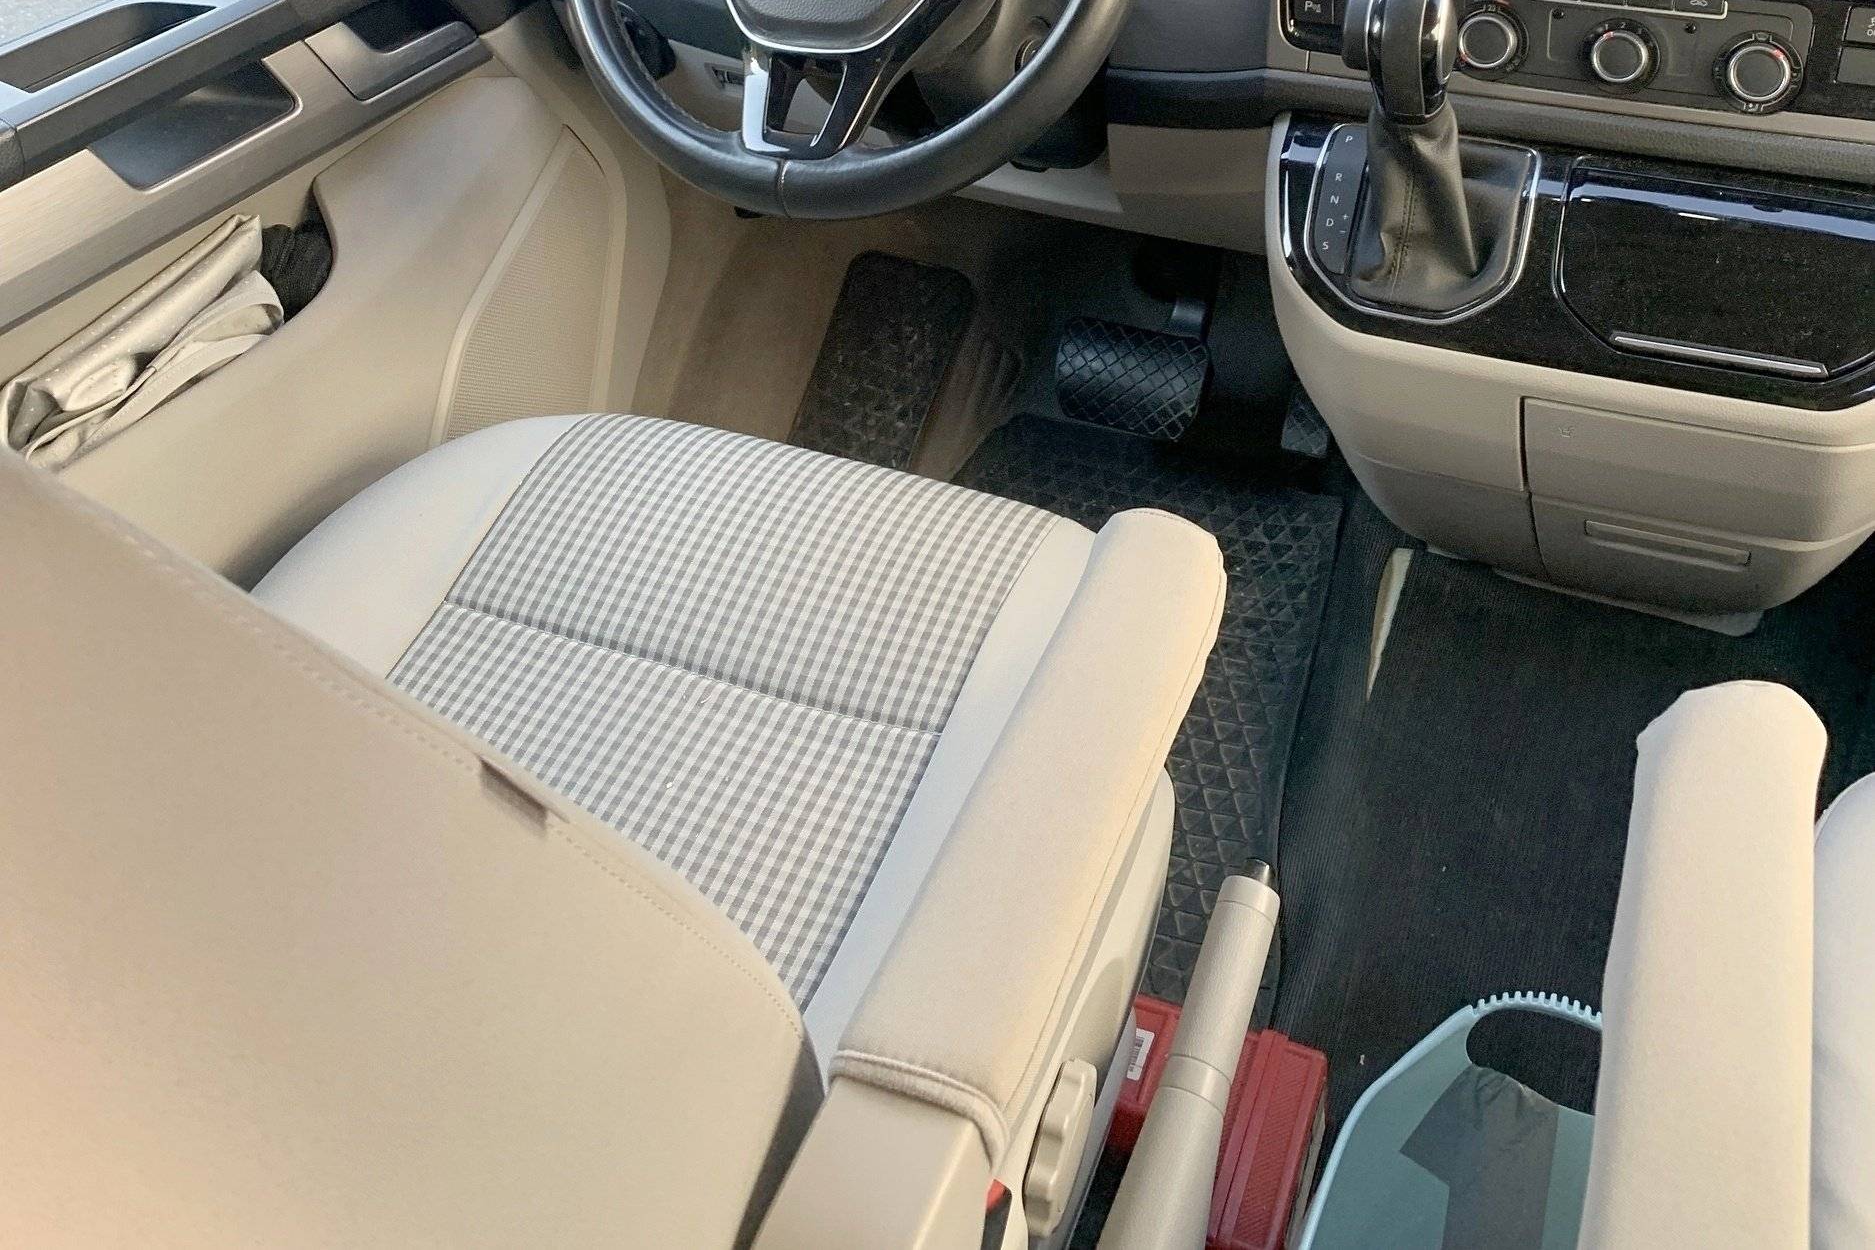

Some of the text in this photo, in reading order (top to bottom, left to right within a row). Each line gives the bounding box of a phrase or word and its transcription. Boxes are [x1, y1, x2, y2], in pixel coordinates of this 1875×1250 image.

[1345, 135, 1353, 143] P
[1335, 173, 1342, 181] R
[1330, 195, 1339, 204] N
[1326, 218, 1334, 227] D
[1322, 241, 1329, 250] S
